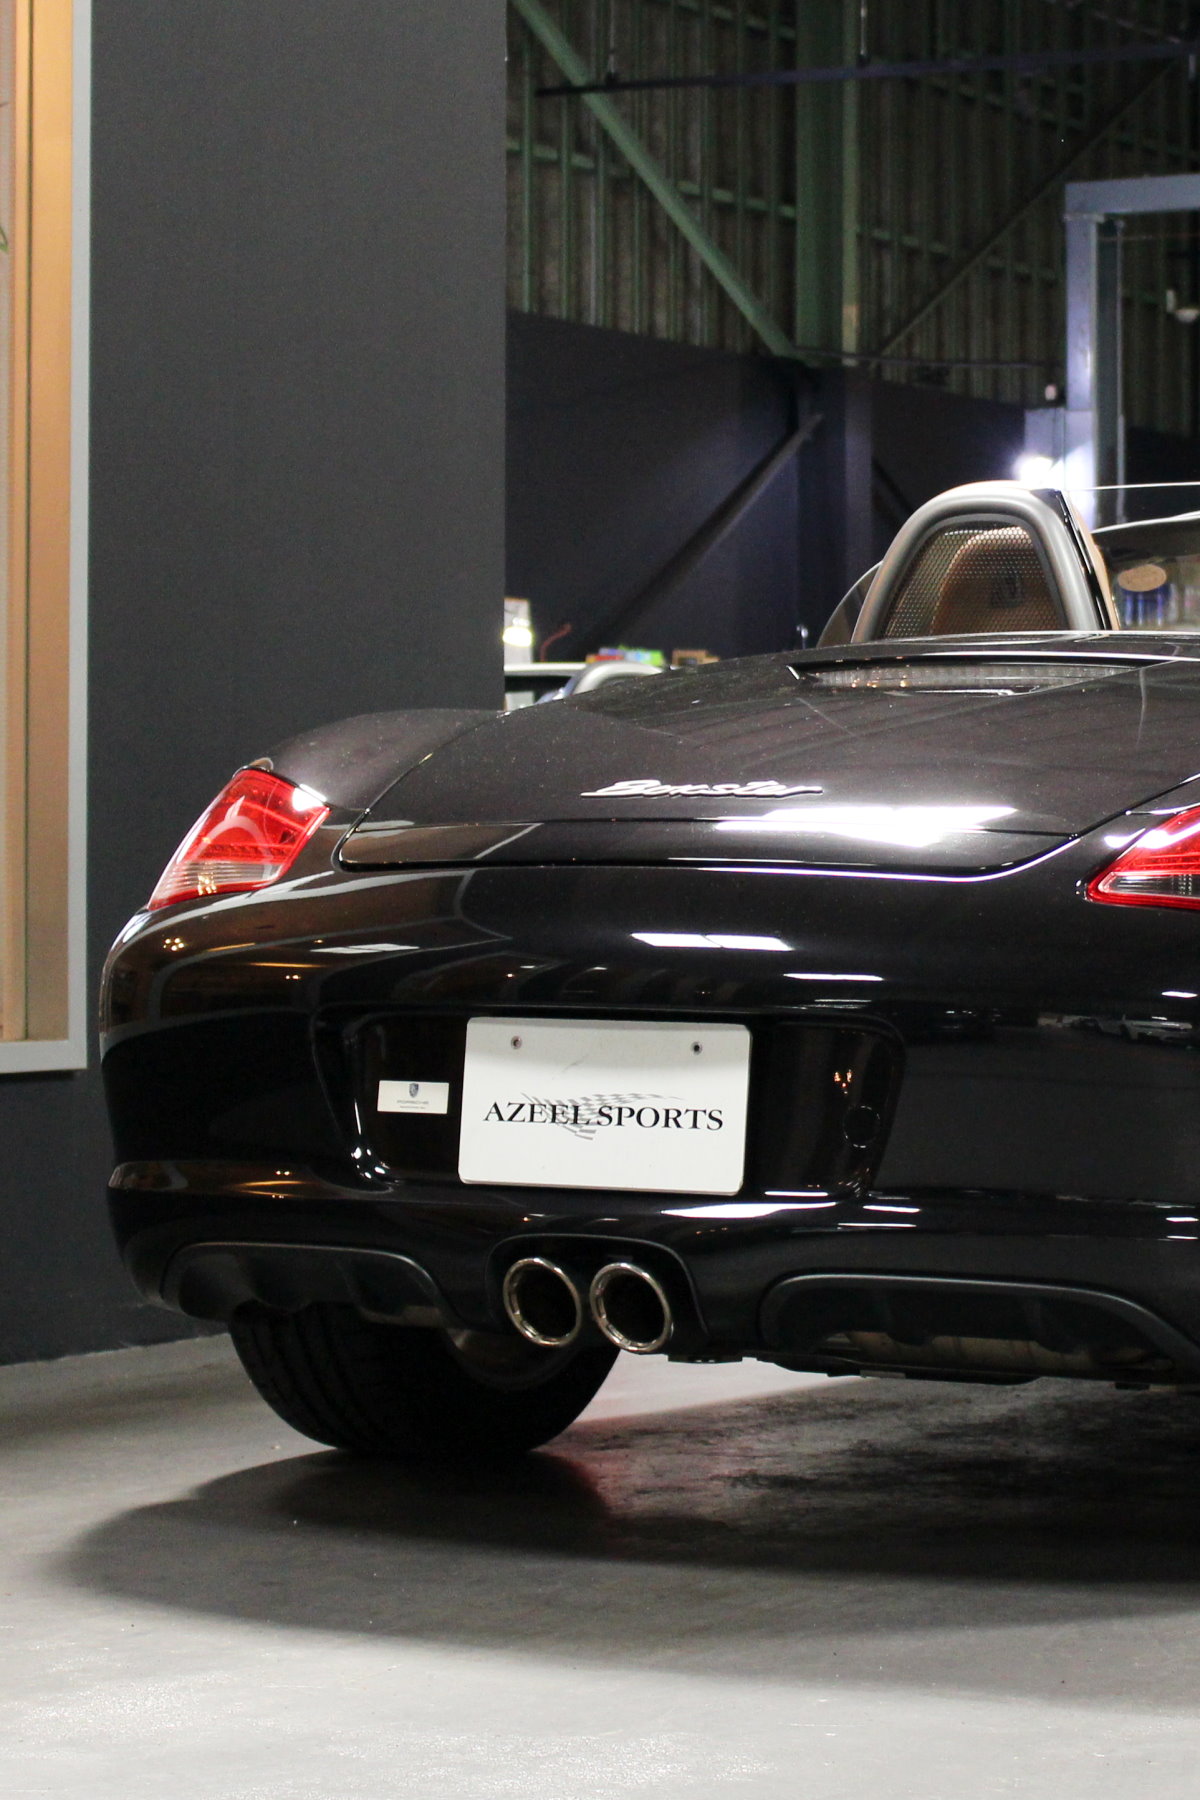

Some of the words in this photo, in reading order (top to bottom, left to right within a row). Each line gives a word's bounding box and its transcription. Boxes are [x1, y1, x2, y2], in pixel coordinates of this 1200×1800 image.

[580, 779, 824, 799] Boxster
[483, 1101, 591, 1125] AZEEL
[596, 1105, 724, 1131] SPORTS
